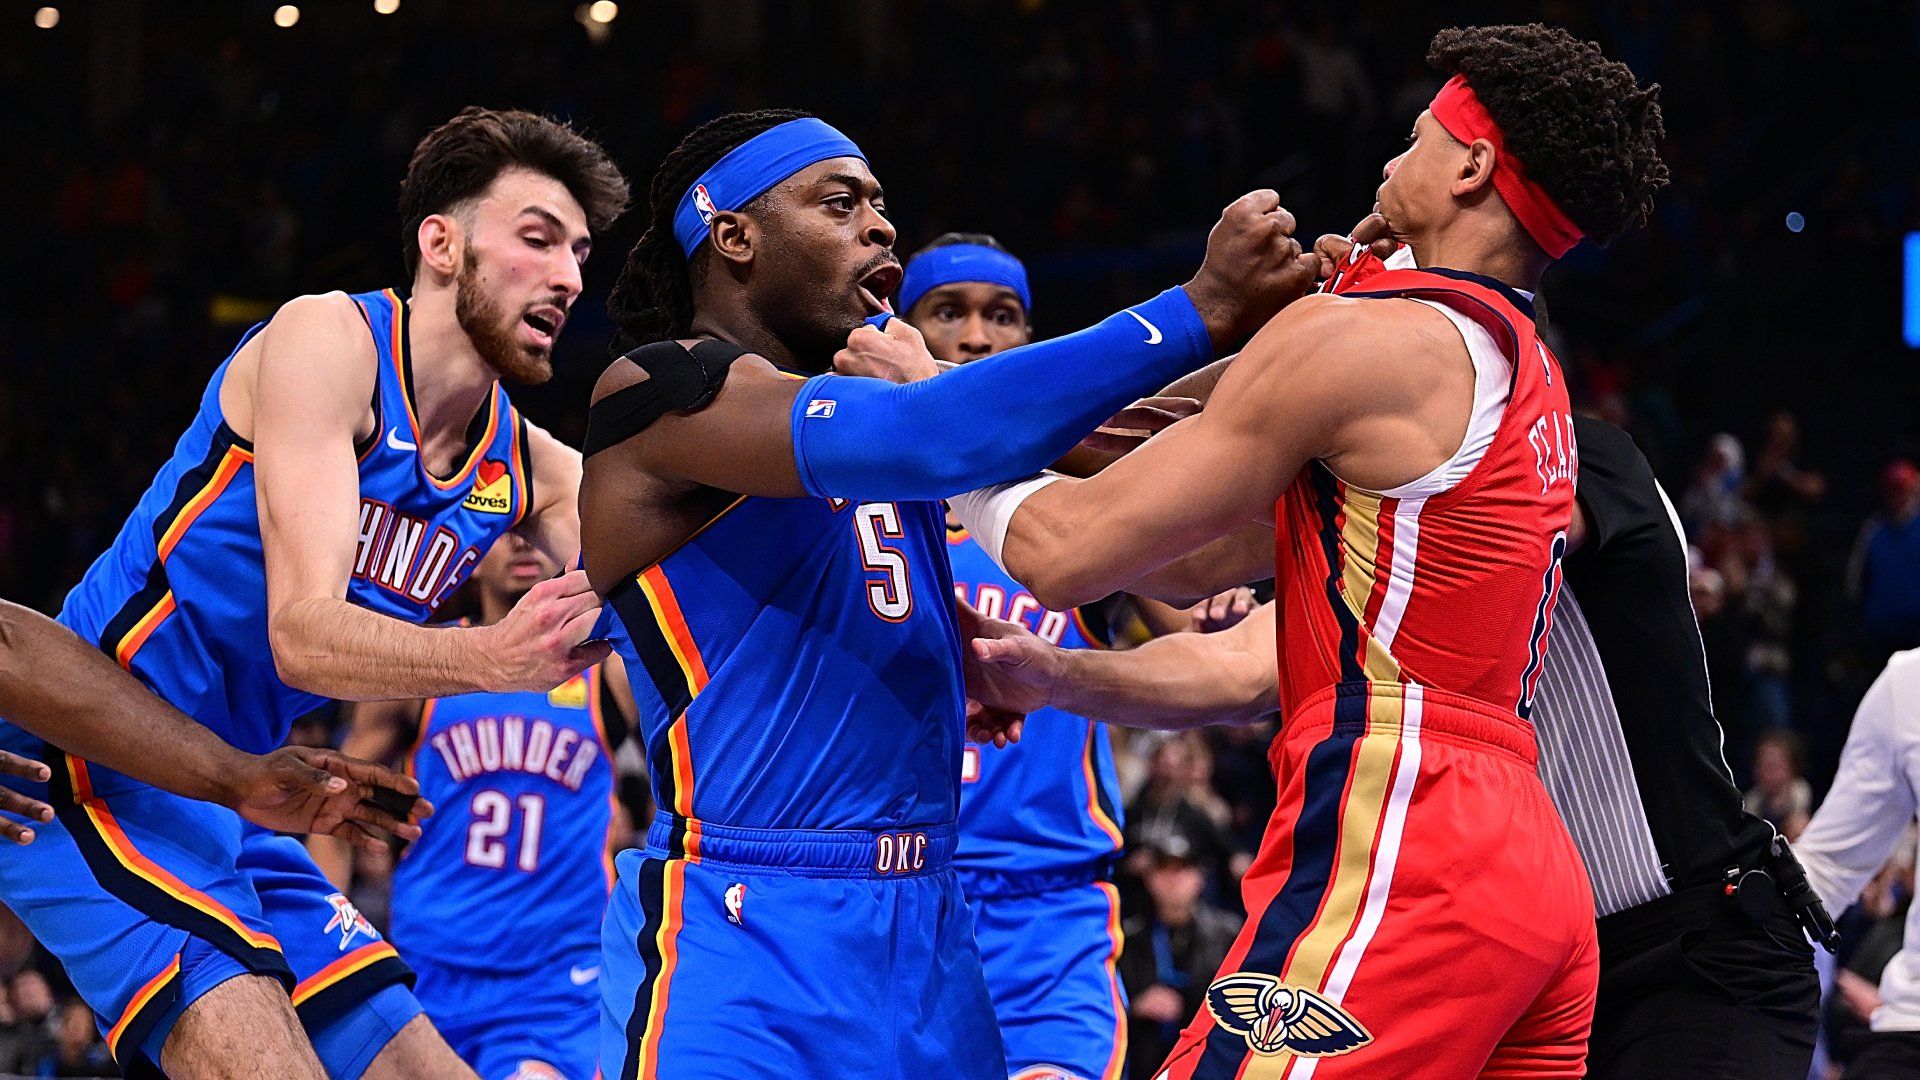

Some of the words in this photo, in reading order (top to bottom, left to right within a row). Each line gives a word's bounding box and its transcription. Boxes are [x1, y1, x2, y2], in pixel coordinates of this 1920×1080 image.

[1527, 408, 1578, 496] FEAR
[354, 498, 480, 610] HUNDE
[852, 500, 913, 622] 5
[430, 715, 599, 792] THUNDER
[465, 789, 545, 873] 21
[876, 832, 927, 873] OKC
